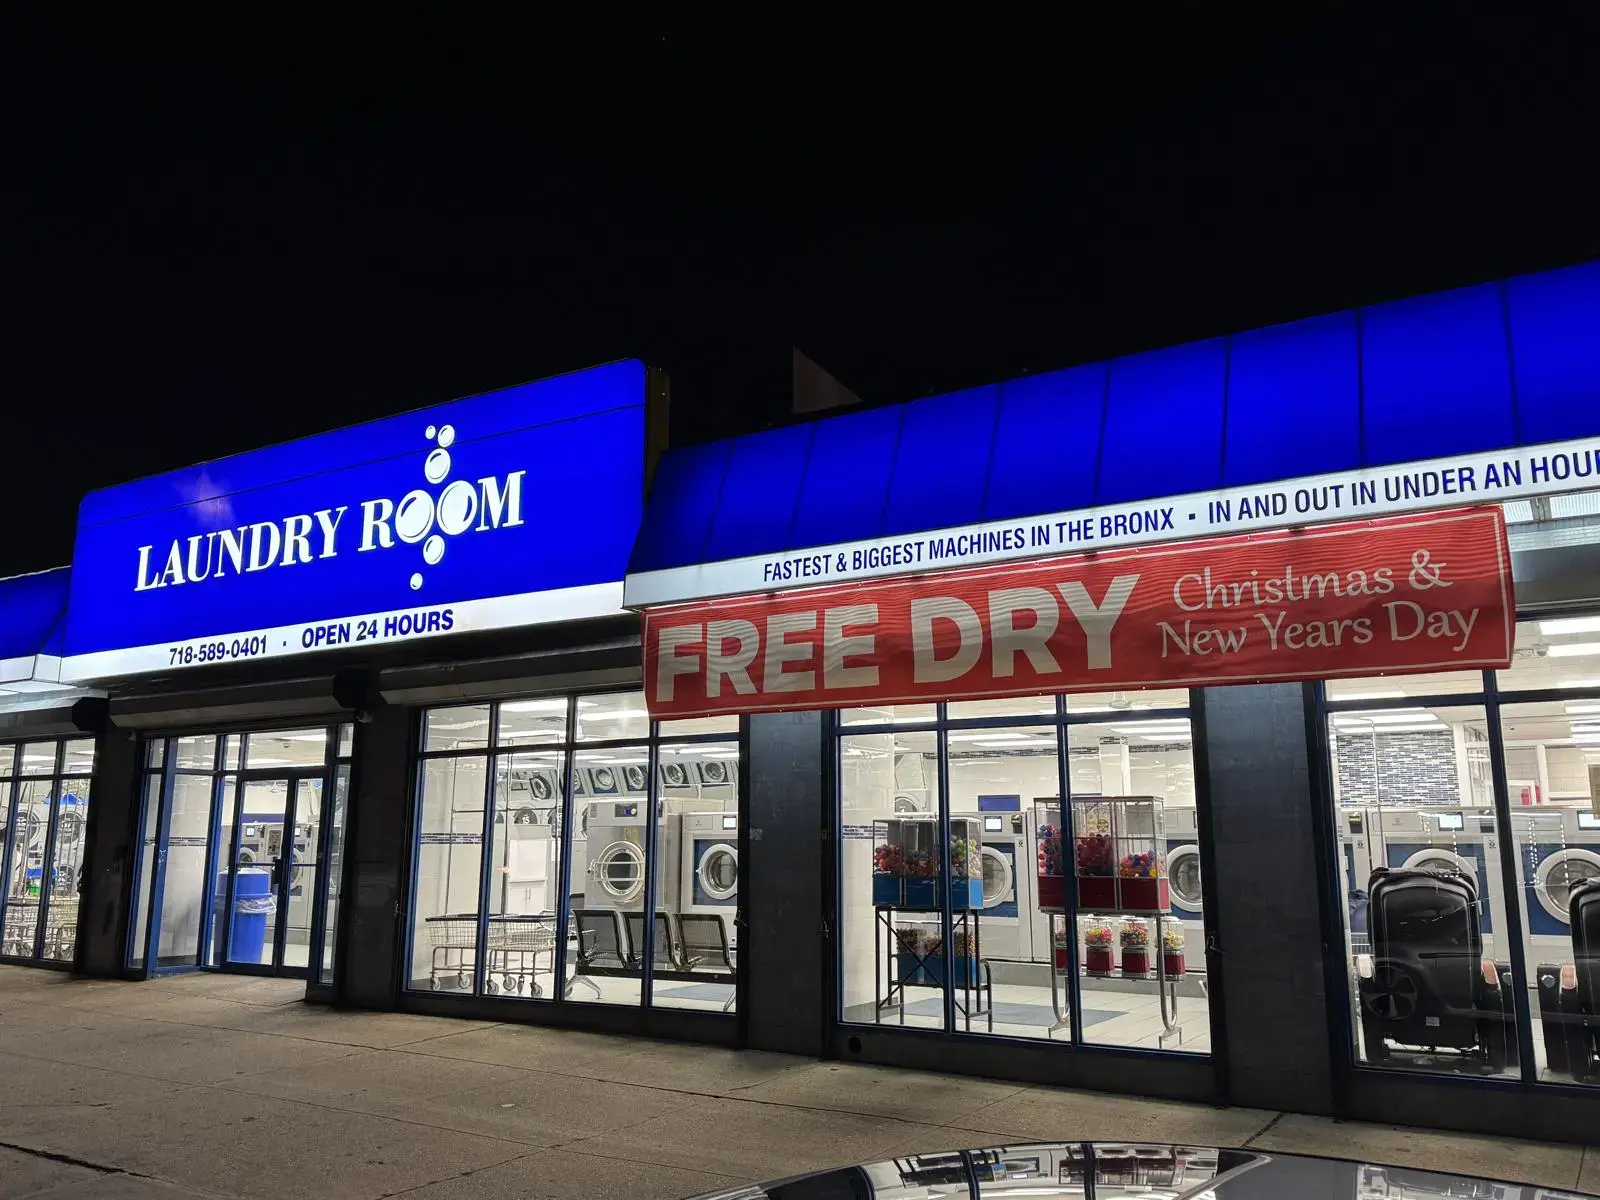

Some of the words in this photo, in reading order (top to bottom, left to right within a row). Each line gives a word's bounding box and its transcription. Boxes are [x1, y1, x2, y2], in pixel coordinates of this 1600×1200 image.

[134, 506, 348, 592] LAUNDRY
[358, 470, 526, 553] ROOM
[764, 554, 832, 582] FASTEST
[835, 553, 848, 573] &
[852, 541, 924, 571] BIGGEST
[928, 527, 1025, 560] MACHINES
[1031, 524, 1050, 546] IN
[1055, 516, 1095, 543] THE
[1100, 507, 1175, 538] BRONX
[1208, 500, 1231, 524] IN
[1237, 492, 1288, 521] AND
[1294, 484, 1344, 514] OUT
[1351, 480, 1376, 506] IN
[1384, 466, 1477, 501] UNDER
[1484, 459, 1522, 489] AN
[1173, 566, 1395, 611] Christmas
[1408, 548, 1453, 590] &
[169, 636, 268, 666] 718-589-0401
[301, 623, 351, 649] OPEN
[357, 619, 379, 642] 24
[383, 609, 454, 637] HOURS
[656, 603, 880, 702] FREE
[910, 574, 1140, 684] DRY
[1156, 619, 1247, 658] New
[1254, 611, 1373, 652] Years
[1382, 600, 1480, 651] Day
